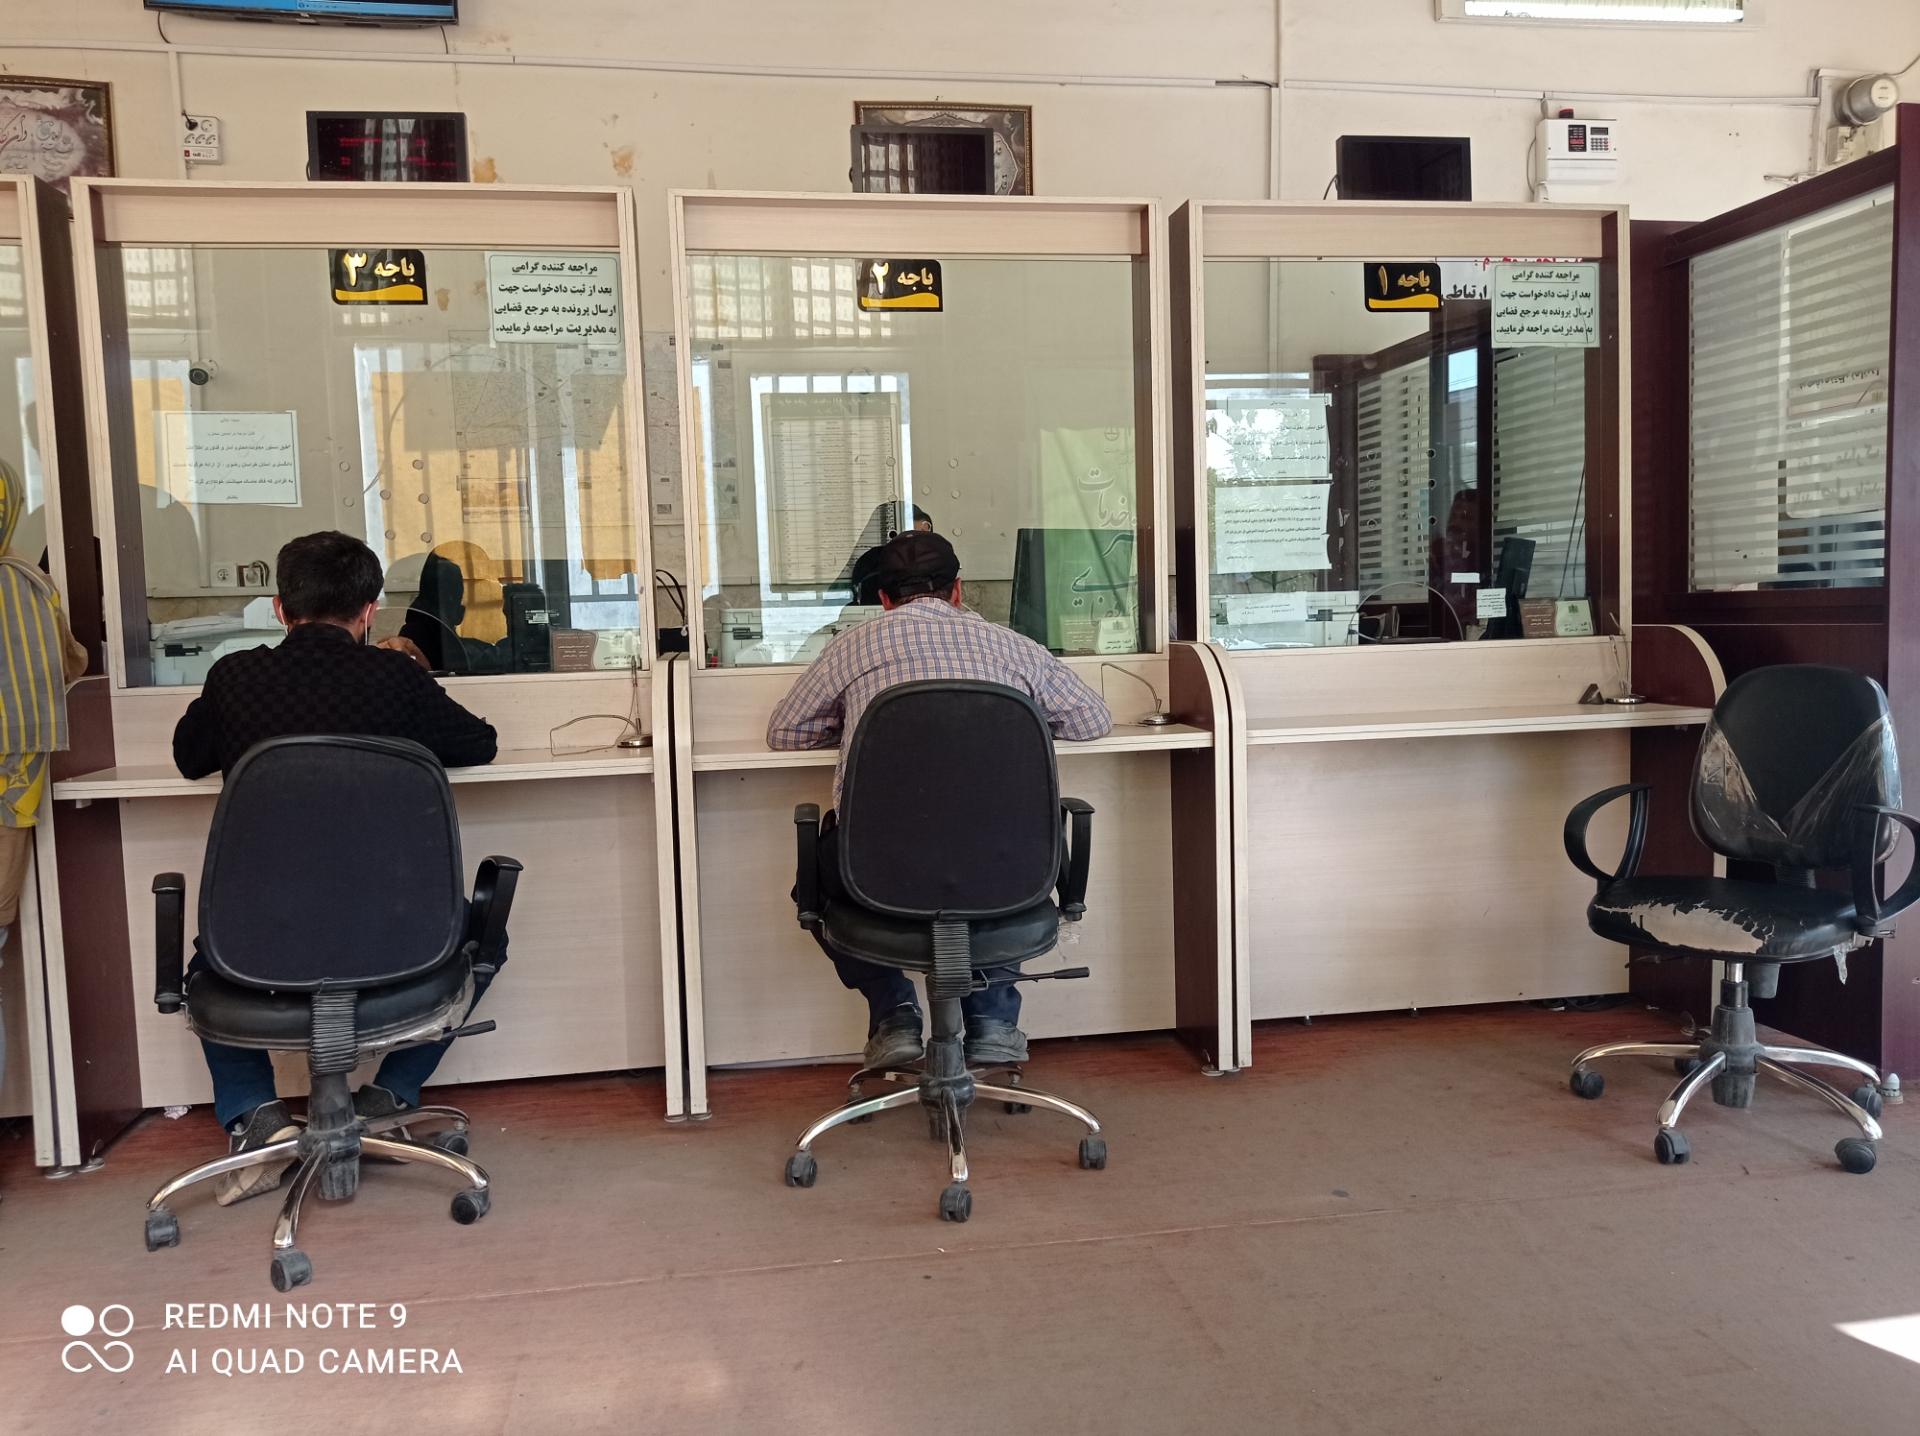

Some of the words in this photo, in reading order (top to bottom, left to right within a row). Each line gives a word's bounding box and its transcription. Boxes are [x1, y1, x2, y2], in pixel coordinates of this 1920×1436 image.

[343, 252, 367, 287] ۳
[374, 257, 415, 283] باجه
[511, 261, 540, 274] گرامی
[541, 262, 566, 272] کننده
[567, 263, 598, 274] مراجعه
[872, 262, 889, 294] ۲
[897, 267, 934, 292] باجه
[1511, 270, 1534, 281] گرامی
[1534, 270, 1554, 279] کننده
[1555, 271, 1580, 281] مراجعه
[1378, 265, 1388, 296] ۱
[1398, 269, 1431, 293] باجه
[498, 283, 520, 295] جهت
[521, 283, 568, 296] دادخواست
[569, 284, 586, 296] ثبت
[587, 285, 596, 296] از
[597, 286, 612, 296] بعد
[1556, 289, 1570, 300] ثبت
[1500, 290, 1518, 300] جهت
[1518, 289, 1556, 301] دادخواست
[1570, 290, 1579, 301] از
[1579, 290, 1591, 300] بعد
[524, 305, 550, 316] مرجع
[551, 305, 560, 314] به
[561, 304, 590, 317] پرونده
[591, 304, 616, 317] ارسال
[1519, 308, 1541, 318] مرجع
[1540, 308, 1549, 317] به
[1548, 308, 1572, 319] پرونده
[1573, 307, 1594, 318] ارسال
[532, 323, 564, 336] مراجعه
[566, 323, 607, 337] مدیریت
[608, 325, 617, 336] به
[1525, 324, 1551, 336] مراجعه
[1550, 325, 1585, 337] مدیریت
[1585, 326, 1594, 335] به
